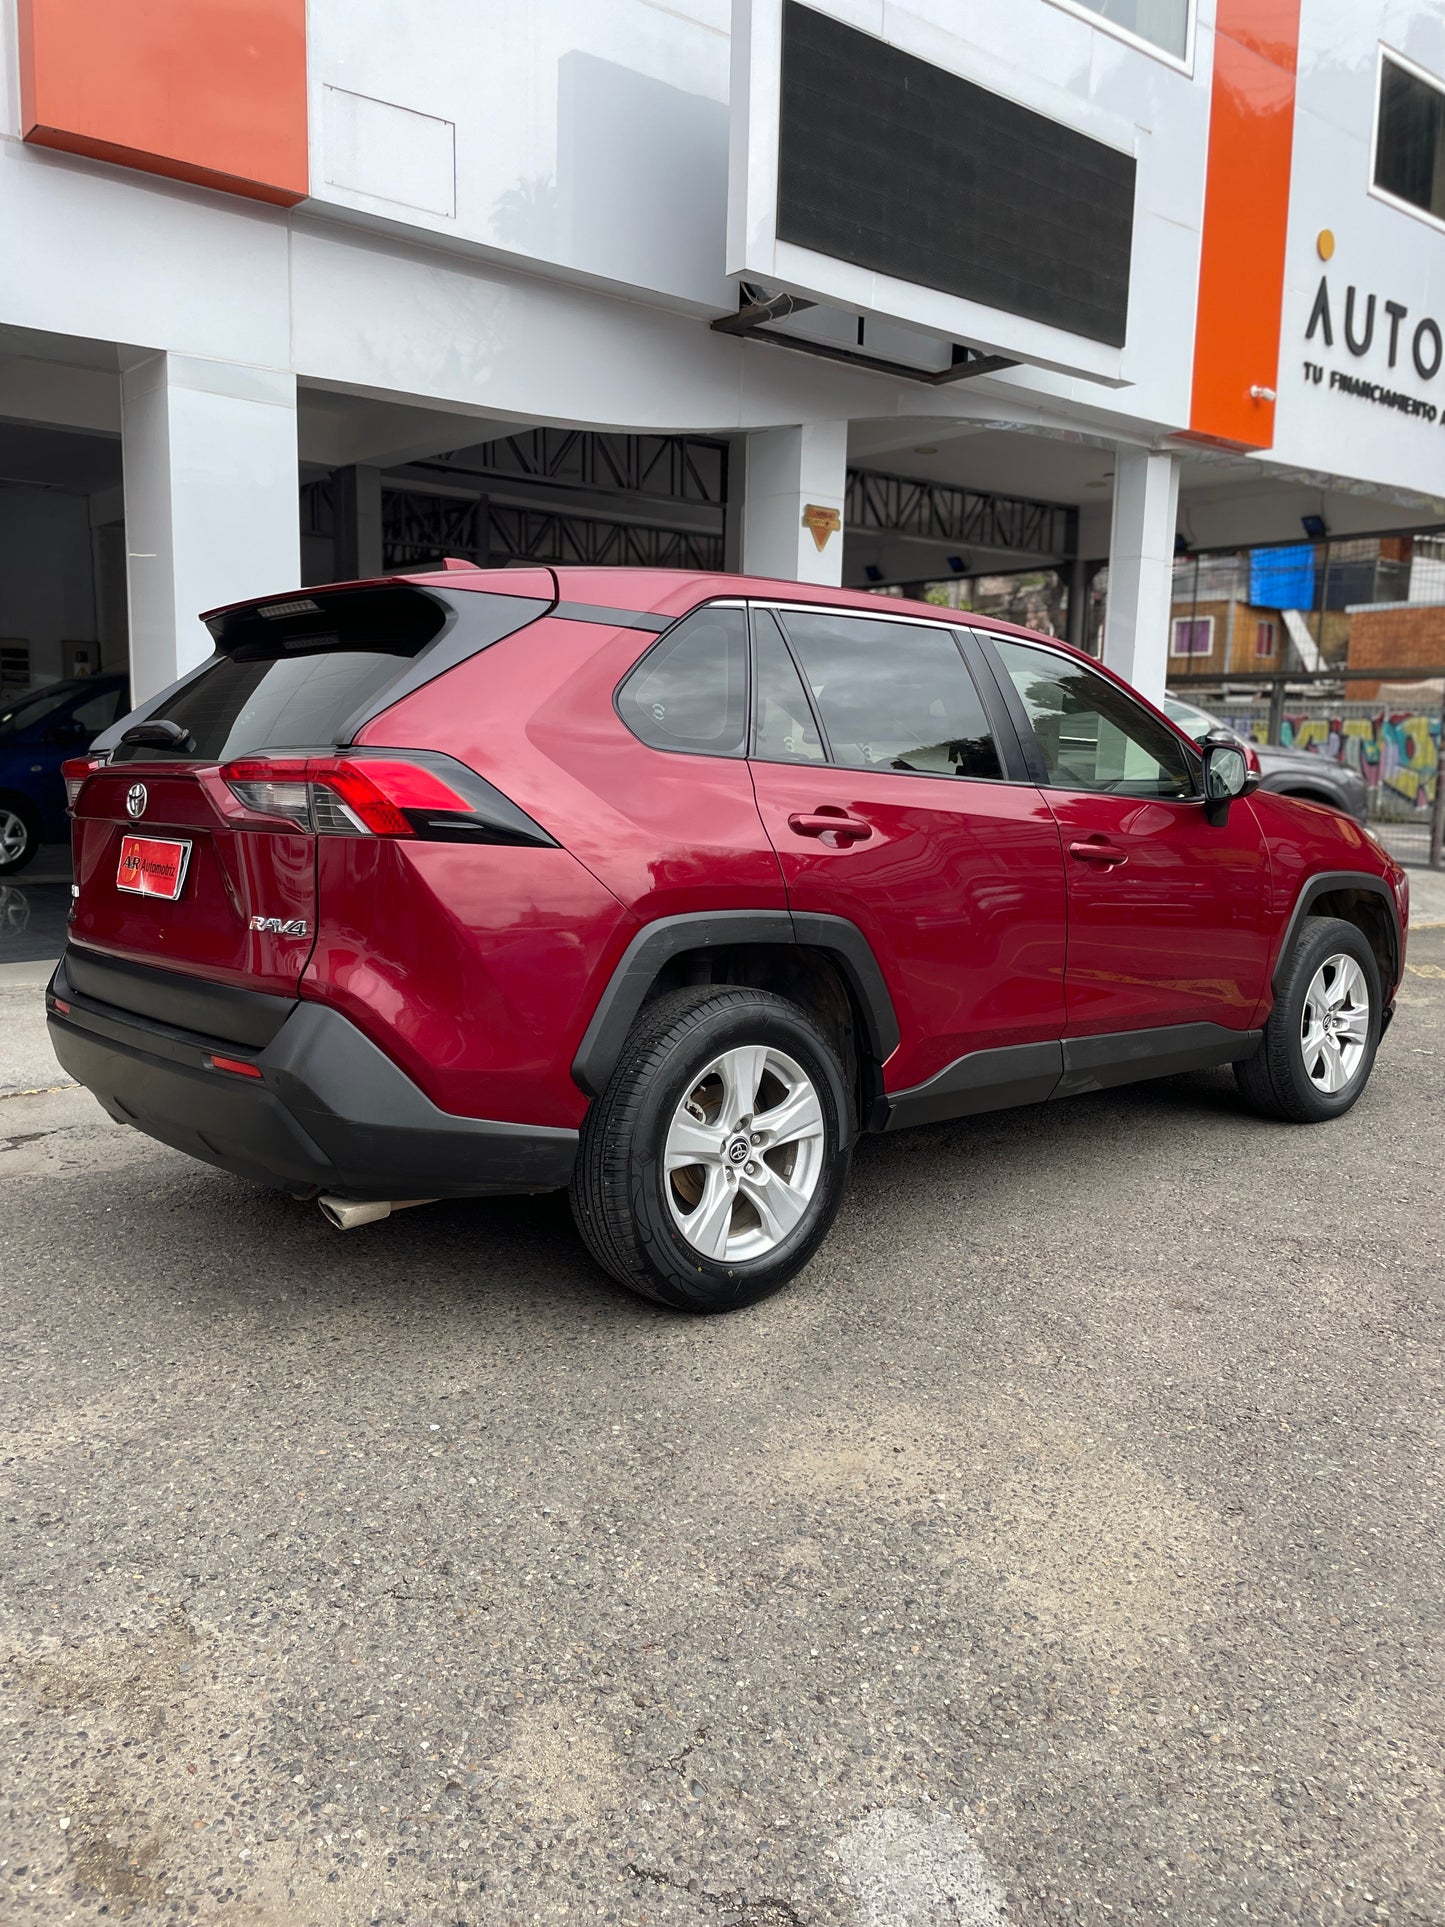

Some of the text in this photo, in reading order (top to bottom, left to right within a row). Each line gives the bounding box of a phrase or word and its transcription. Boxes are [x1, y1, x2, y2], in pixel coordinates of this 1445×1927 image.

[1304, 275, 1443, 380] AUTO
[1303, 361, 1323, 384] TU
[1330, 371, 1437, 422] FINANCIAMIENTO
[141, 859, 175, 877] Automotriz
[249, 915, 307, 936] RAV4
